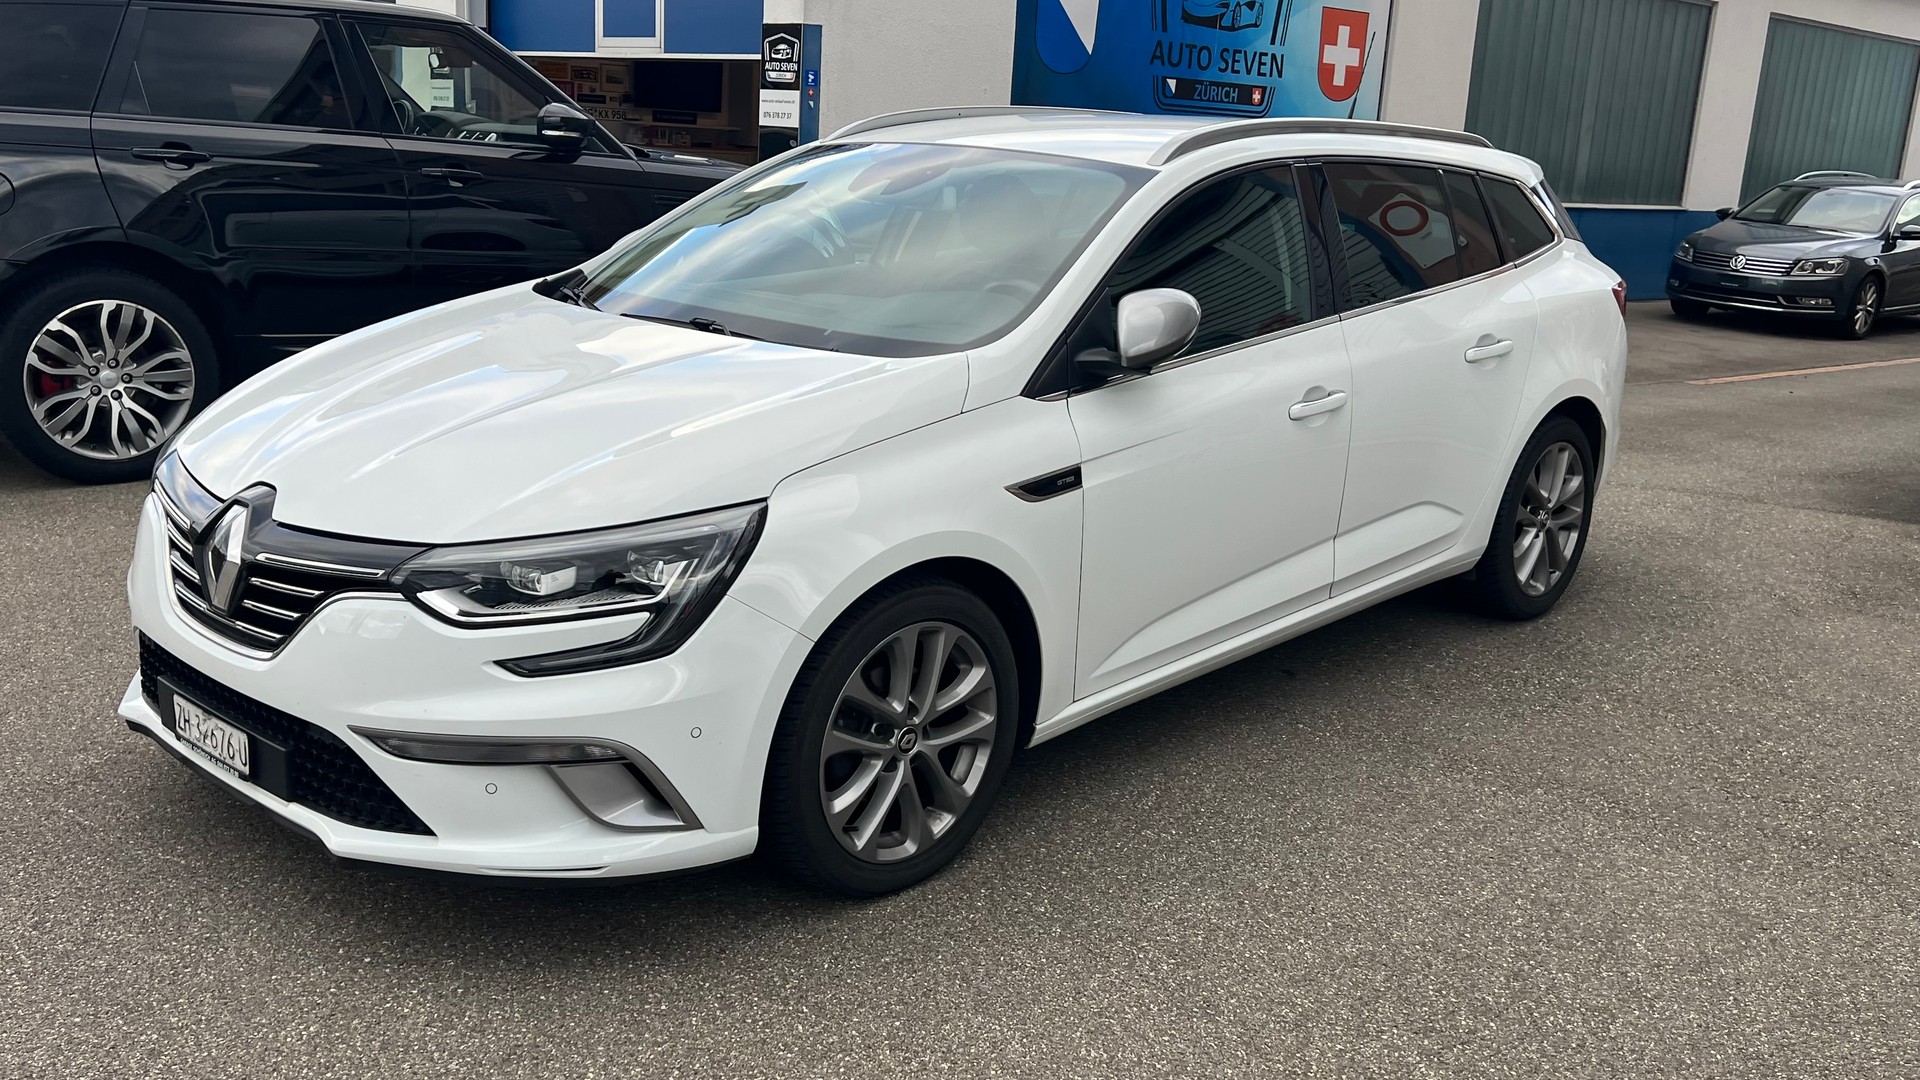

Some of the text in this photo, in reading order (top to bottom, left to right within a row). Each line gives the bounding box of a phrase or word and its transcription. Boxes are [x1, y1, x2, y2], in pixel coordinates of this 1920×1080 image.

[1150, 39, 1286, 79] AUTO SEVEN
[764, 61, 798, 72] AUTO SEVEN
[1193, 81, 1239, 103] ZÜRICH
[611, 110, 627, 120] 958
[772, 111, 780, 119] 378
[786, 112, 792, 120] 37
